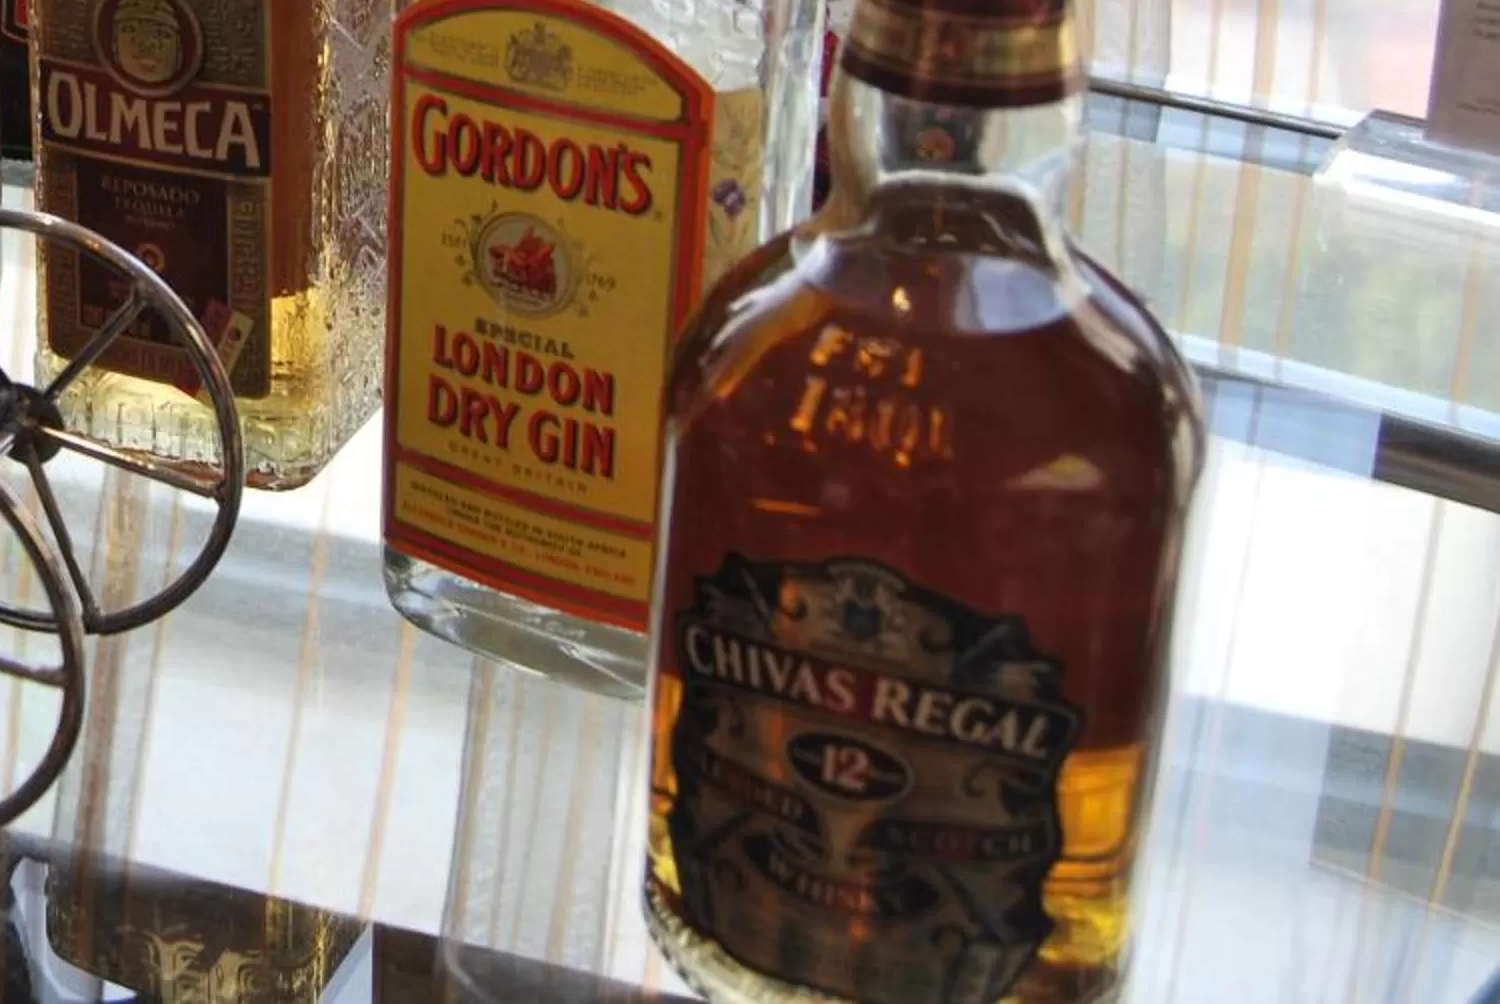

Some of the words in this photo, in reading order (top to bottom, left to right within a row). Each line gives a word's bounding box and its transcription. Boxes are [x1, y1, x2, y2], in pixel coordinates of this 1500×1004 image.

[46, 69, 262, 169] OLMECA
[412, 93, 654, 217] GORDON'S
[433, 323, 616, 417] LONDON
[475, 318, 575, 359] SPECIAL
[426, 373, 520, 451] DRY
[527, 408, 616, 481] GIN
[685, 624, 859, 715] CHIVAS
[869, 676, 1051, 759] REGAL
[820, 742, 871, 793] 12
